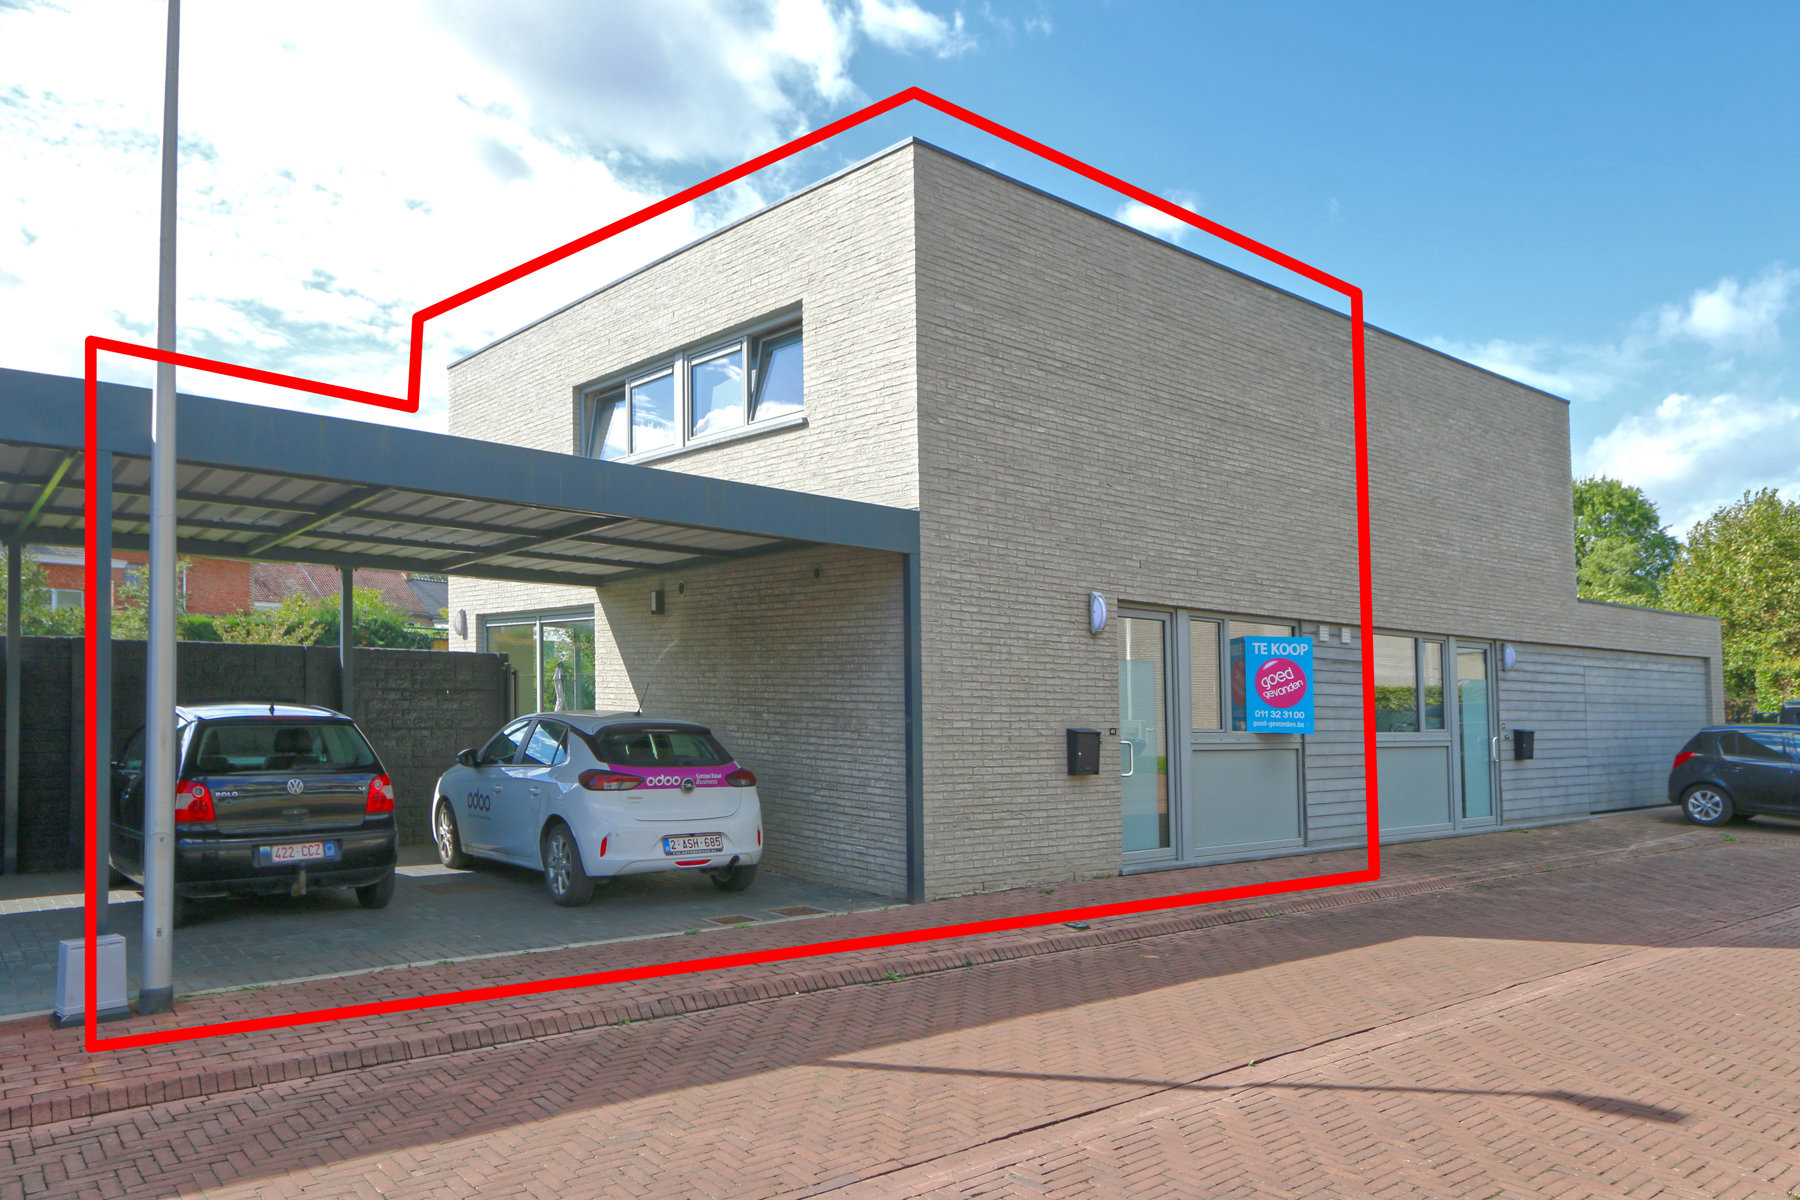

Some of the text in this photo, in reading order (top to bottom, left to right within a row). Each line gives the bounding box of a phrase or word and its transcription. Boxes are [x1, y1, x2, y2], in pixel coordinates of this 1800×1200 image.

[1252, 642, 1268, 655] TE
[1271, 643, 1309, 656] KOOP
[1261, 667, 1294, 690] goed
[1262, 679, 1304, 699] gevonden
[1254, 710, 1269, 718] 011
[1270, 710, 1282, 718] 32
[1253, 720, 1305, 728] goed-gevonden.be
[646, 774, 681, 787] odoo
[467, 787, 491, 812] odoo
